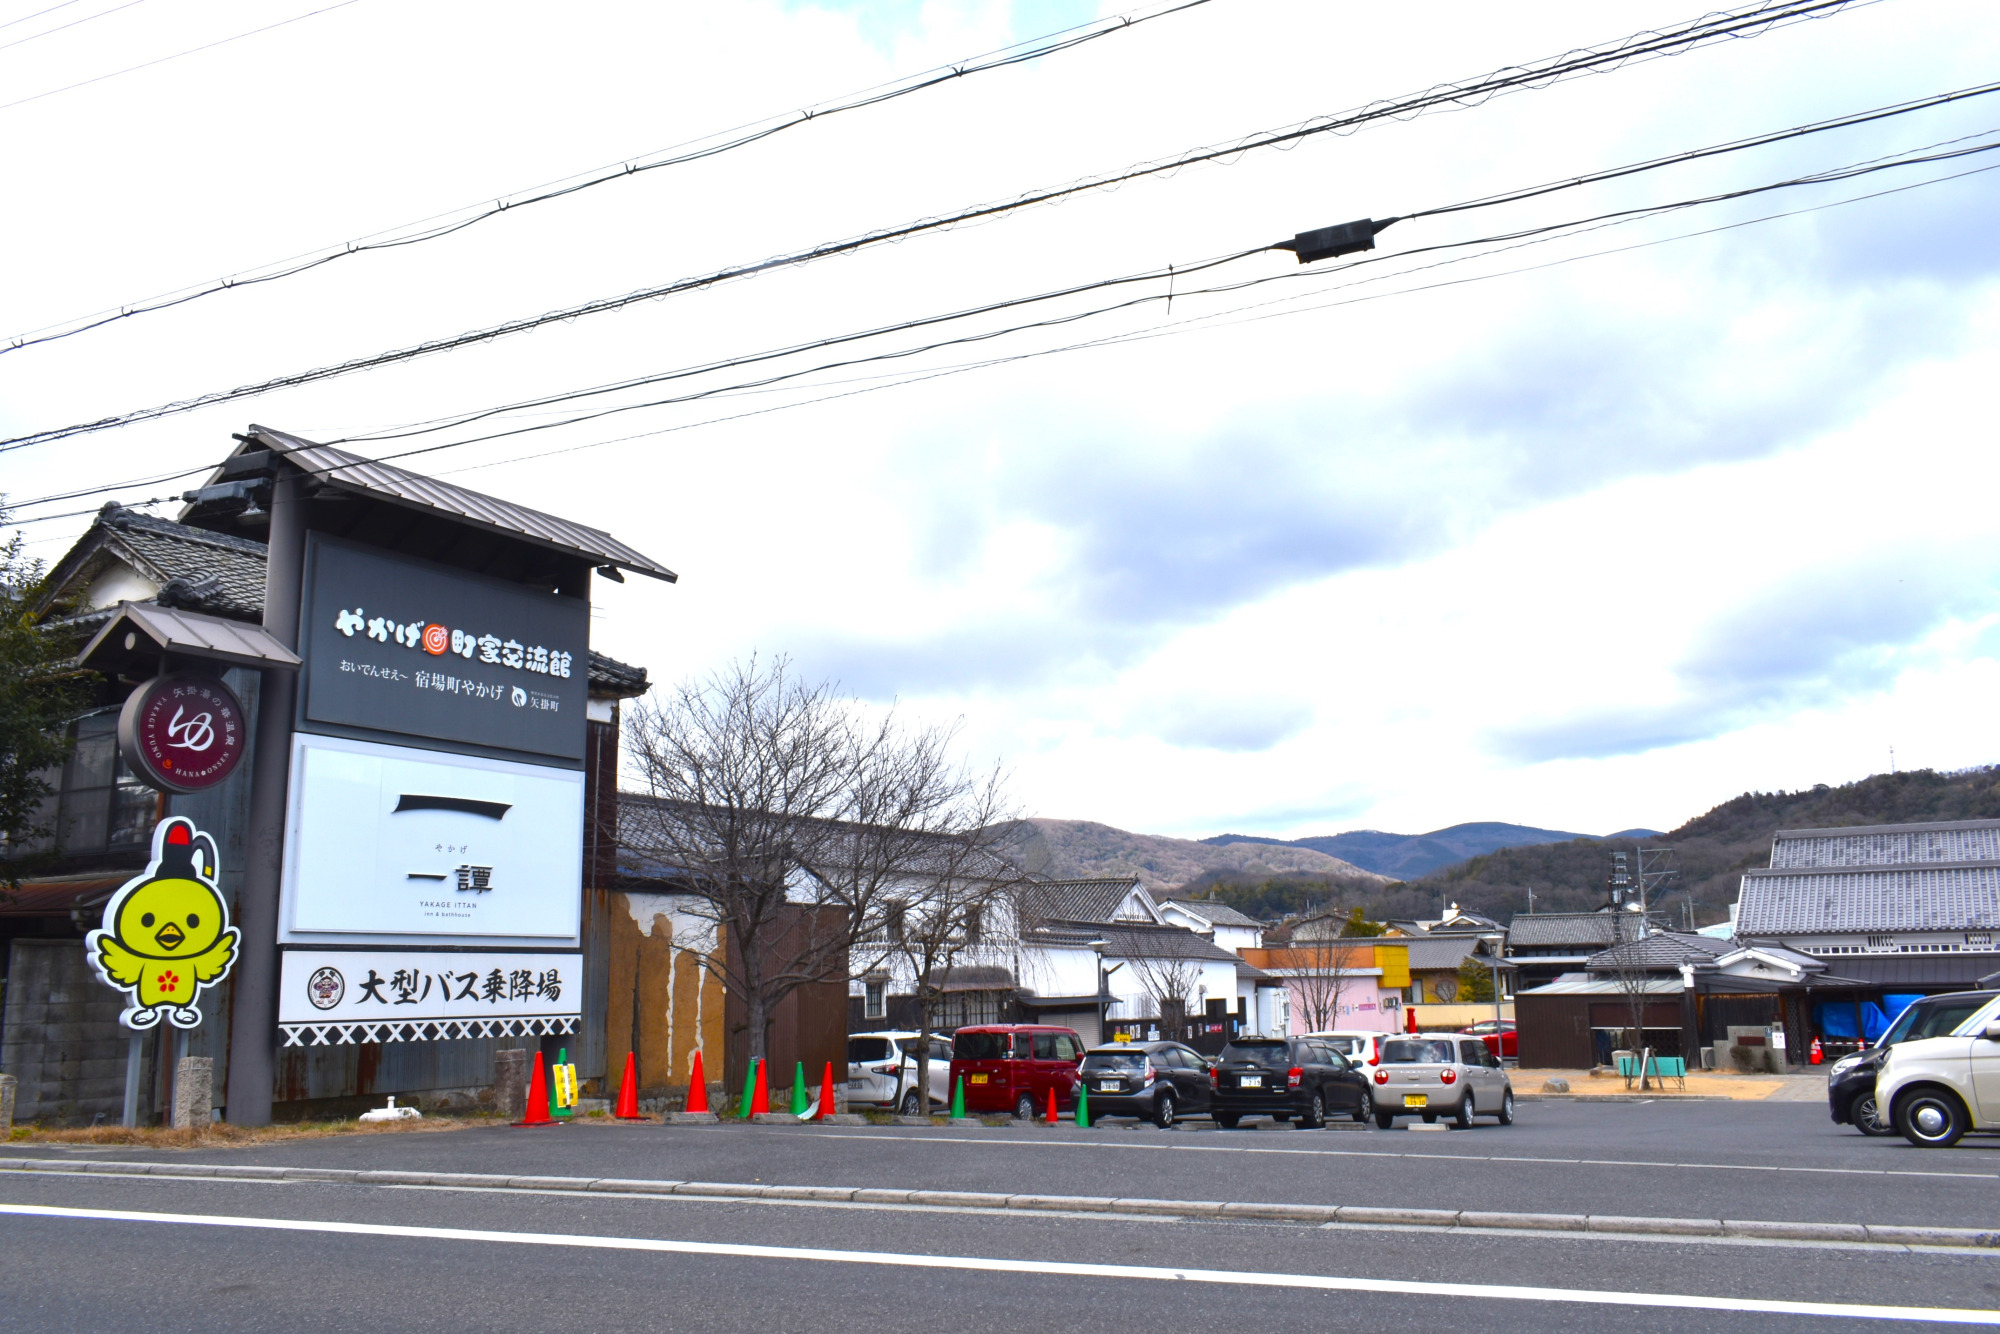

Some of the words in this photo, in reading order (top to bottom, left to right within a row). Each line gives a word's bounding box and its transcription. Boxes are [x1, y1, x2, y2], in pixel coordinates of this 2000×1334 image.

[335, 607, 425, 649] やかげ
[451, 629, 572, 679] 町家交流館
[415, 670, 504, 701] 宿場町やかげ
[147, 696, 168, 729] YAKAGE
[530, 696, 559, 712] 矢掛町
[166, 703, 215, 752] ゆ
[148, 733, 162, 759] YUNO
[175, 767, 200, 778] HANA
[207, 751, 230, 774] ONSEN
[435, 843, 469, 855] やかげ
[419, 900, 451, 909] YAKAGE
[454, 901, 478, 909] ITTAN
[355, 967, 562, 1006] 大型バス乗降場
